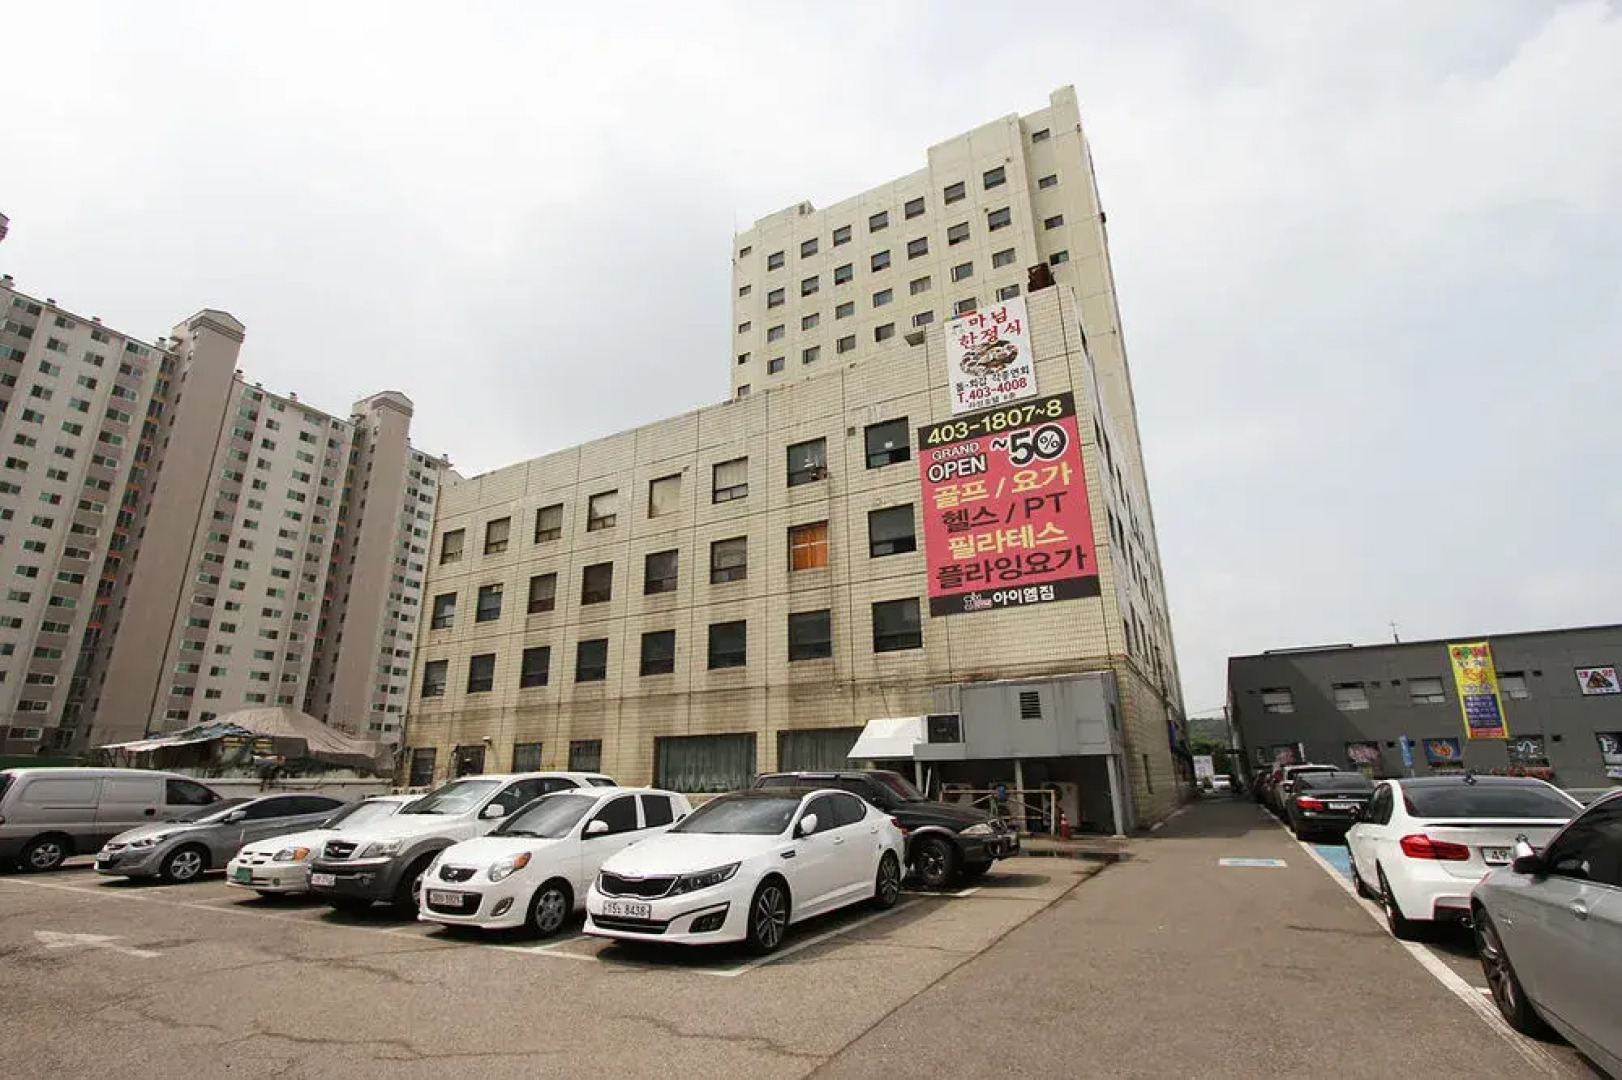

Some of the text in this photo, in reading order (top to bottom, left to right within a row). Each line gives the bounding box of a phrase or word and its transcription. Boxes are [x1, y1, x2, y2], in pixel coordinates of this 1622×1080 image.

[927, 399, 1063, 444] 403-1807~8
[928, 454, 986, 482] OPEN
[932, 441, 980, 461] GRAND
[932, 479, 990, 510] 골프
[1011, 461, 1073, 494] 요가
[942, 505, 1000, 533] 헬스
[1025, 490, 1068, 519] PT
[948, 521, 1069, 560] 필라테스
[936, 544, 1087, 589] 플라잉요가
[993, 584, 1055, 606] 아이엠짐
